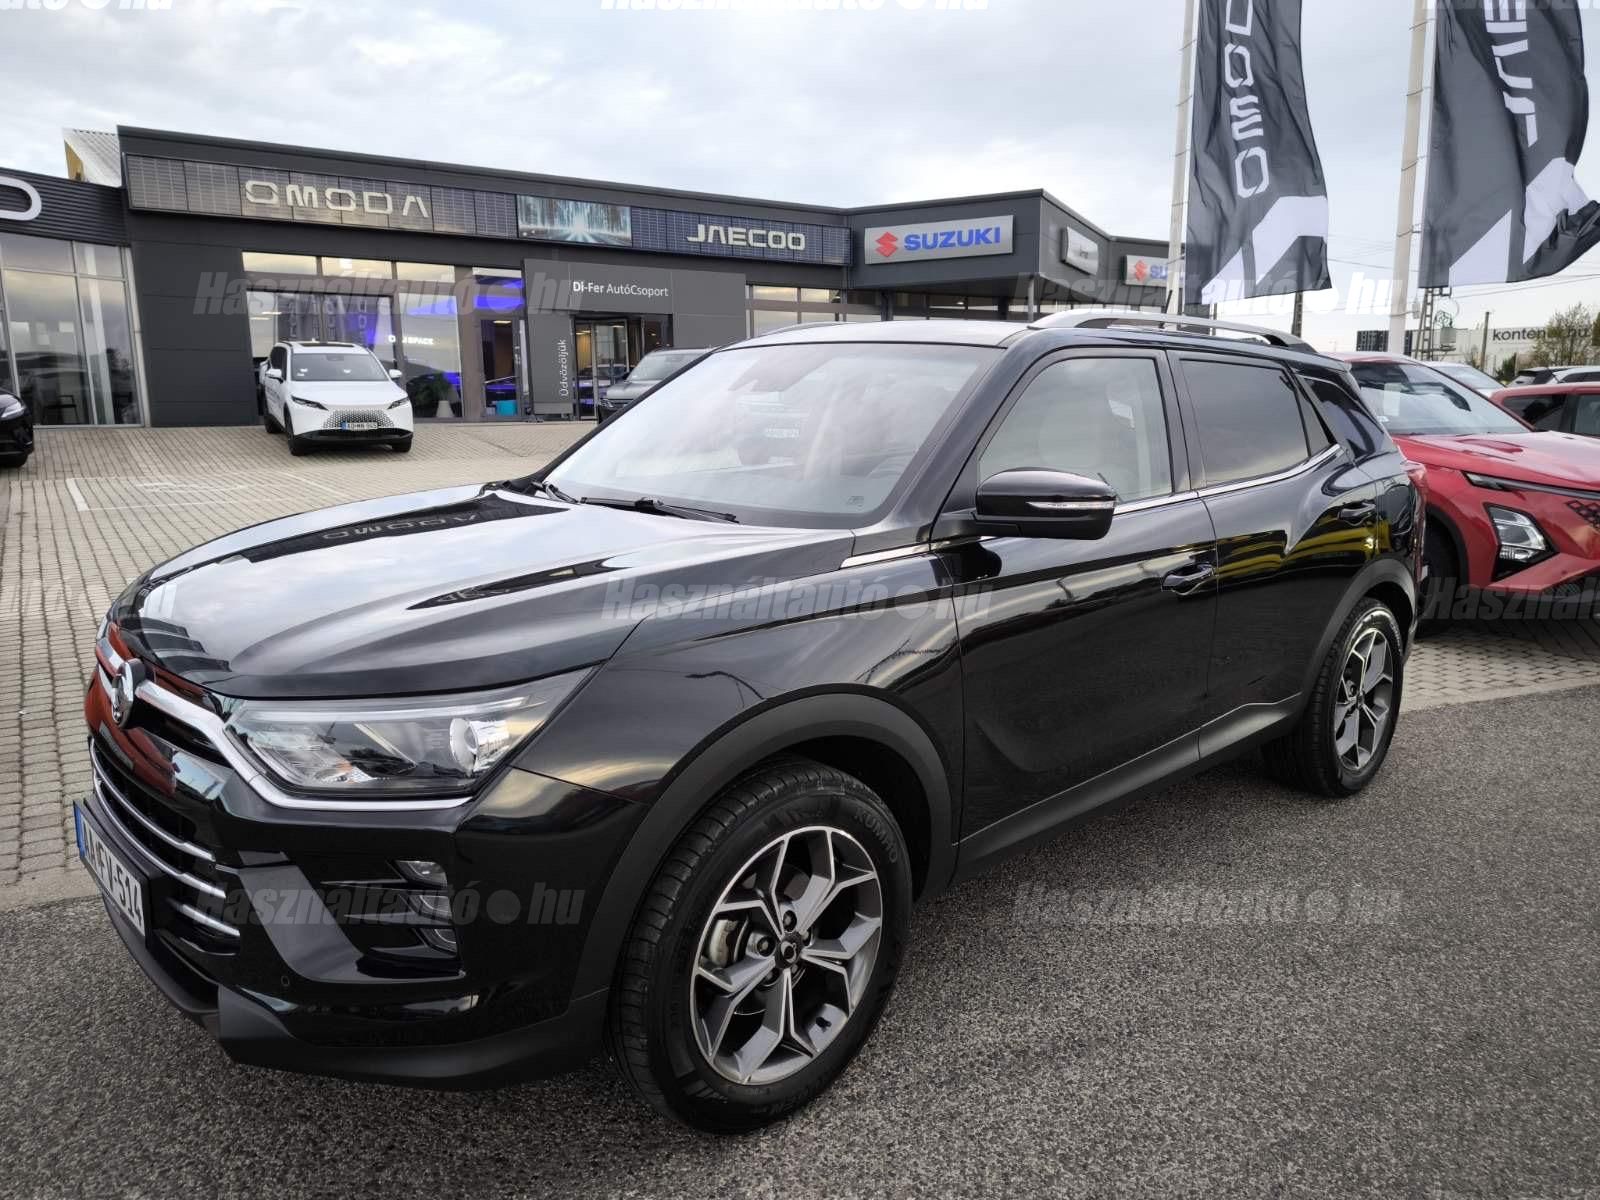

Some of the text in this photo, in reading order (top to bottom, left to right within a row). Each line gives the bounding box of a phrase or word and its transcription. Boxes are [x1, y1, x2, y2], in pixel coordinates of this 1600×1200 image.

[245, 180, 429, 218] OMODA
[686, 223, 806, 251] JAECOO
[903, 226, 1001, 251] SUZUKI
[572, 281, 669, 298] Di-Fer AutóCsoport
[558, 339, 568, 396] Üdvözöljük
